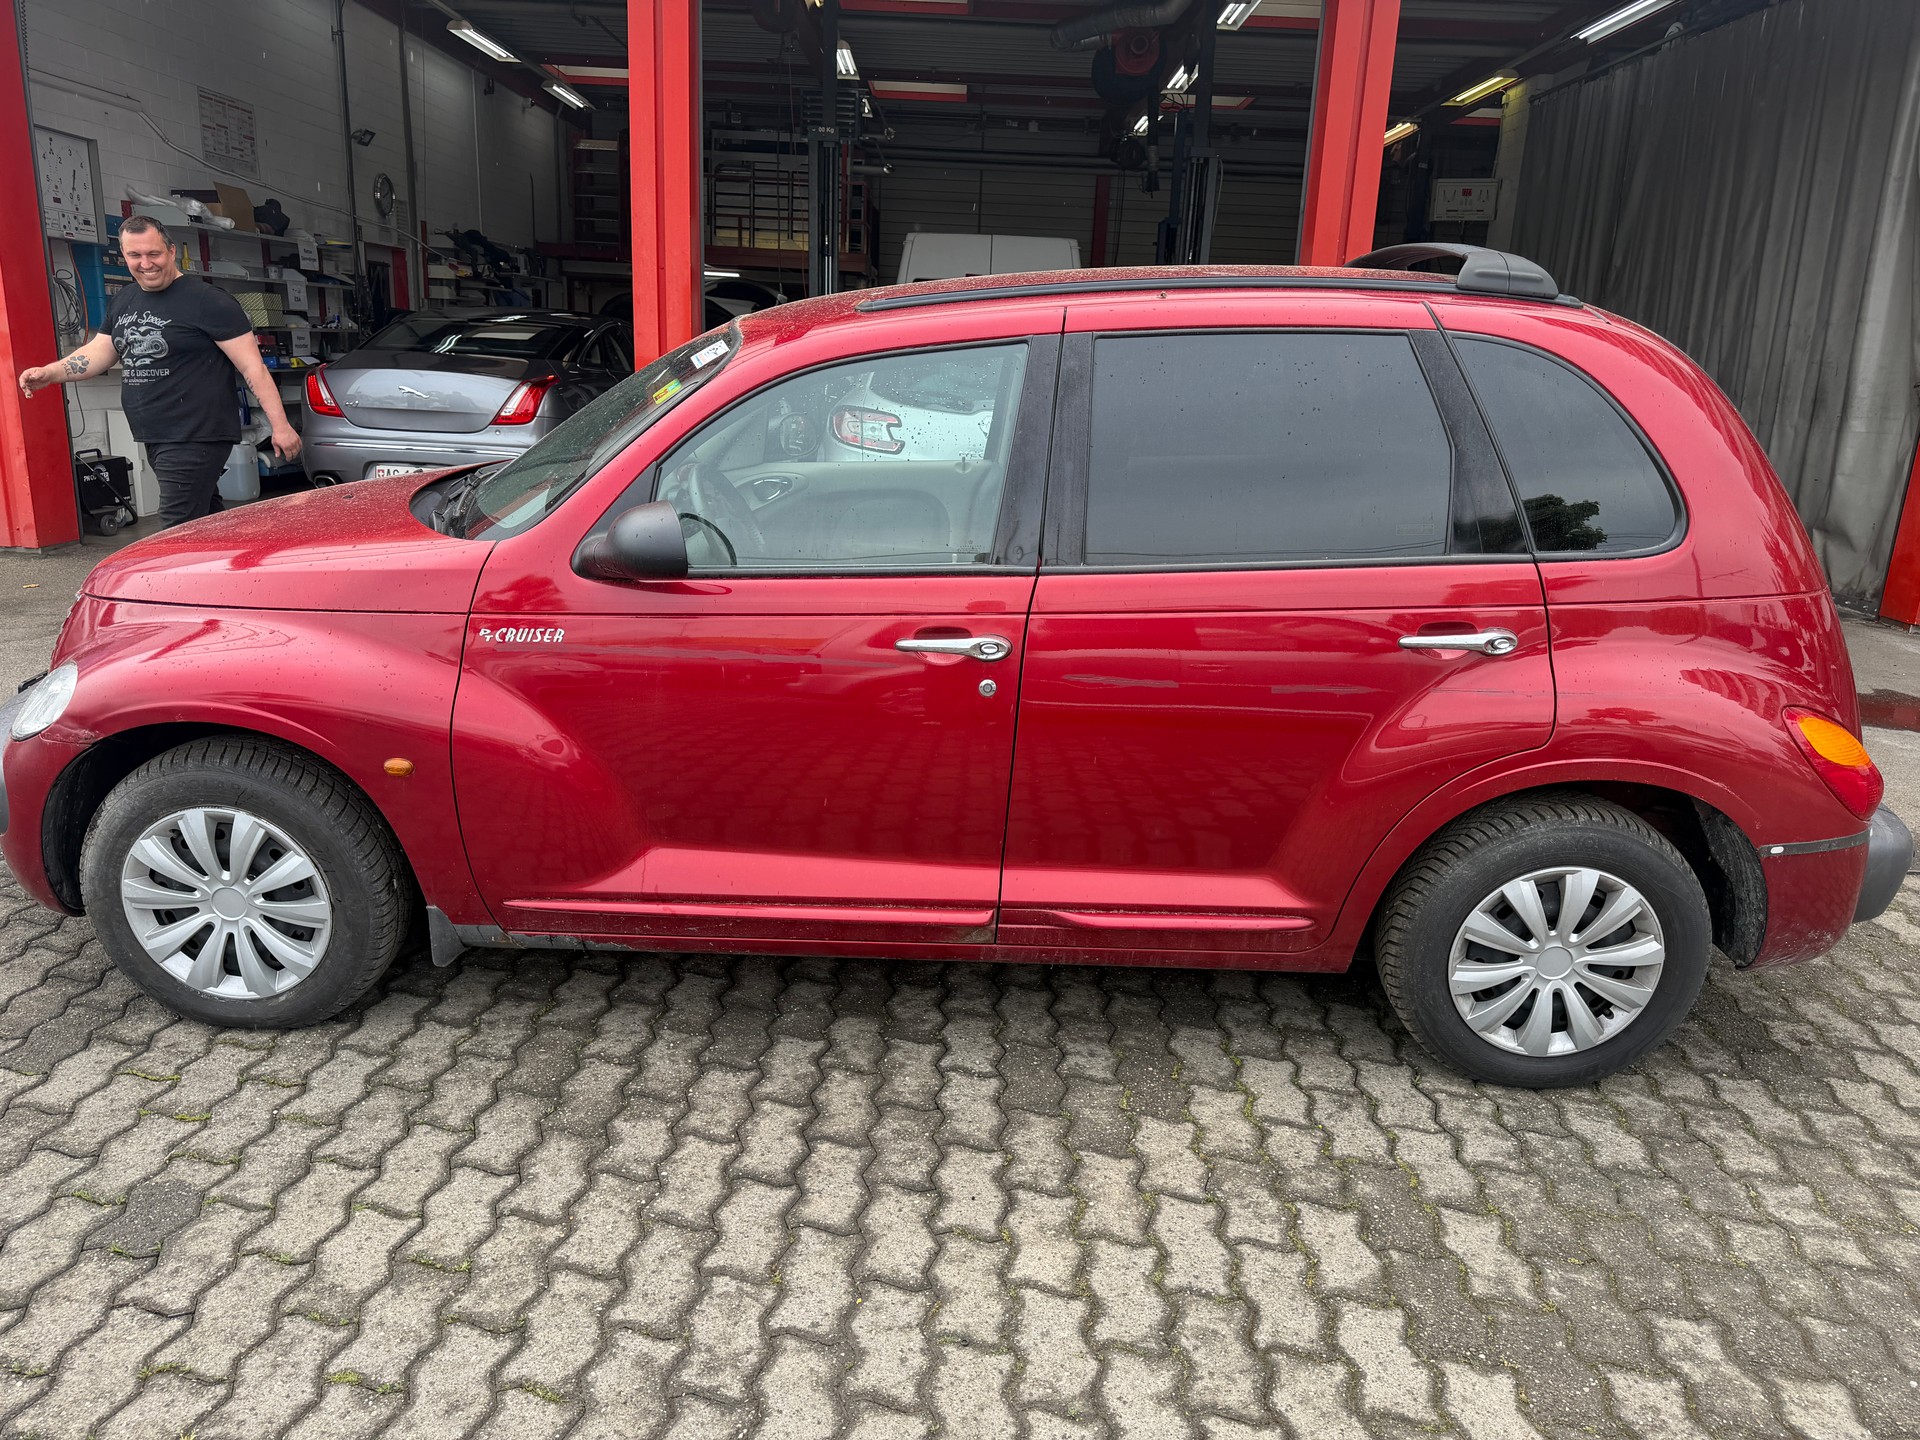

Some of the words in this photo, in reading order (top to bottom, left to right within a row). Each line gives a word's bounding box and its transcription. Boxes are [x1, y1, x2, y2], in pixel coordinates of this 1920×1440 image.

[115, 311, 138, 329] High
[137, 310, 172, 327] Speed
[136, 368, 170, 377] DISCOVER
[479, 628, 494, 642] PT
[495, 627, 565, 643] CRUISER
